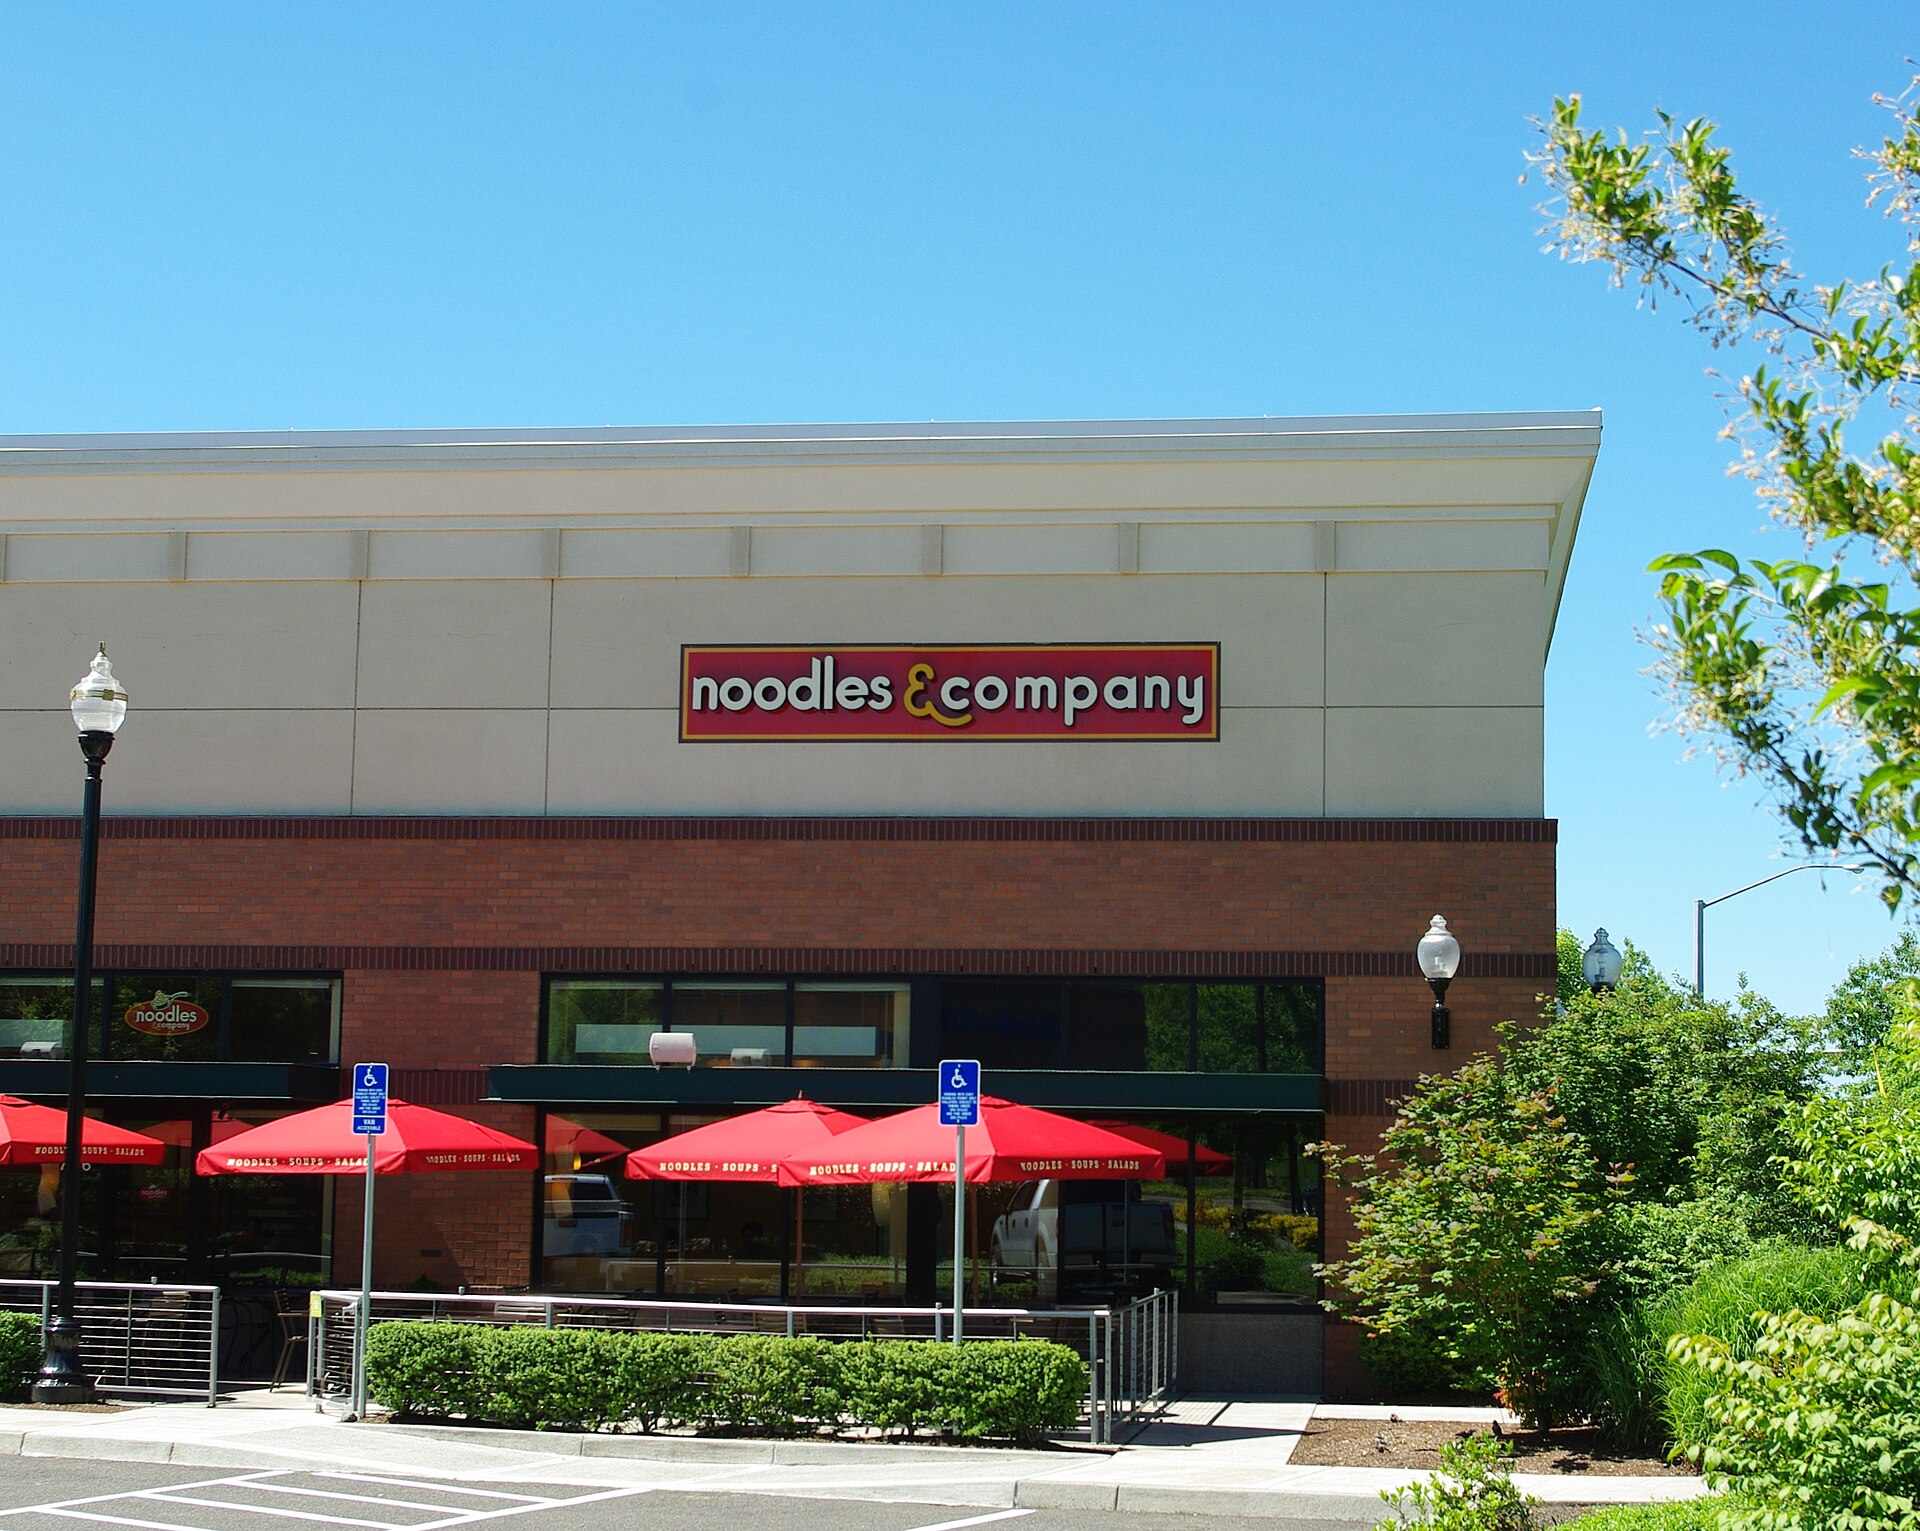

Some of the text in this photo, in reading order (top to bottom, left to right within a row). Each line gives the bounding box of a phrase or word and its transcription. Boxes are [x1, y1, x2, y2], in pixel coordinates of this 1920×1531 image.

[692, 655, 1204, 727] noodles & company
[136, 1004, 197, 1023] noodles
[157, 1022, 190, 1031] company
[115, 1147, 145, 1156] SALADS
[227, 1157, 369, 1167] NOODLES SOUPS SALAD
[463, 1154, 486, 1162] SOUPS
[659, 1162, 711, 1172] NOODLES
[722, 1162, 759, 1173] SOUPS
[809, 1161, 957, 1176] NOODLES SOUPS SALAD
[1020, 1159, 1140, 1171] NOODLES SOUPS SALADS
